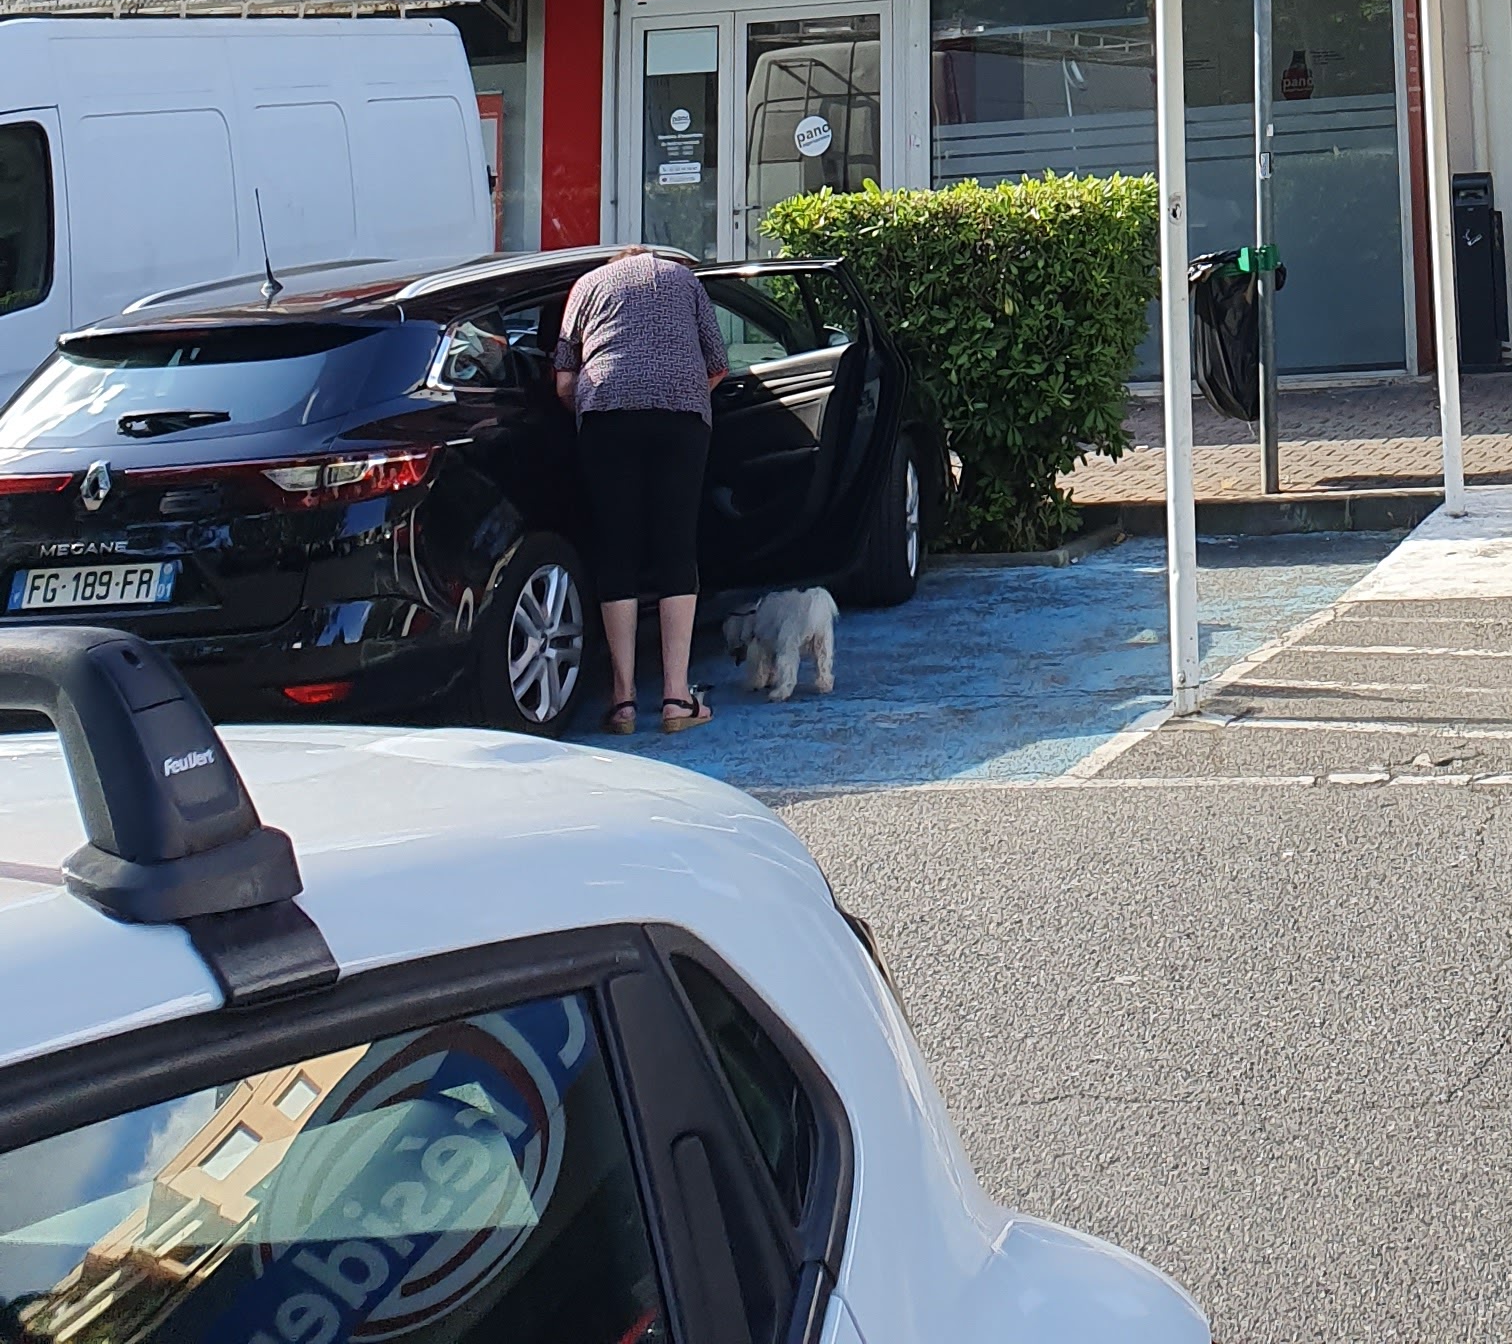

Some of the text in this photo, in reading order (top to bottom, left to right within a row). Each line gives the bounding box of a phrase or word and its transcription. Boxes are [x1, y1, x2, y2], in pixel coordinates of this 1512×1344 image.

[1283, 77, 1313, 92] pano
[797, 123, 831, 148] pano
[39, 540, 129, 558] MEGANE
[157, 583, 172, 598] 01
